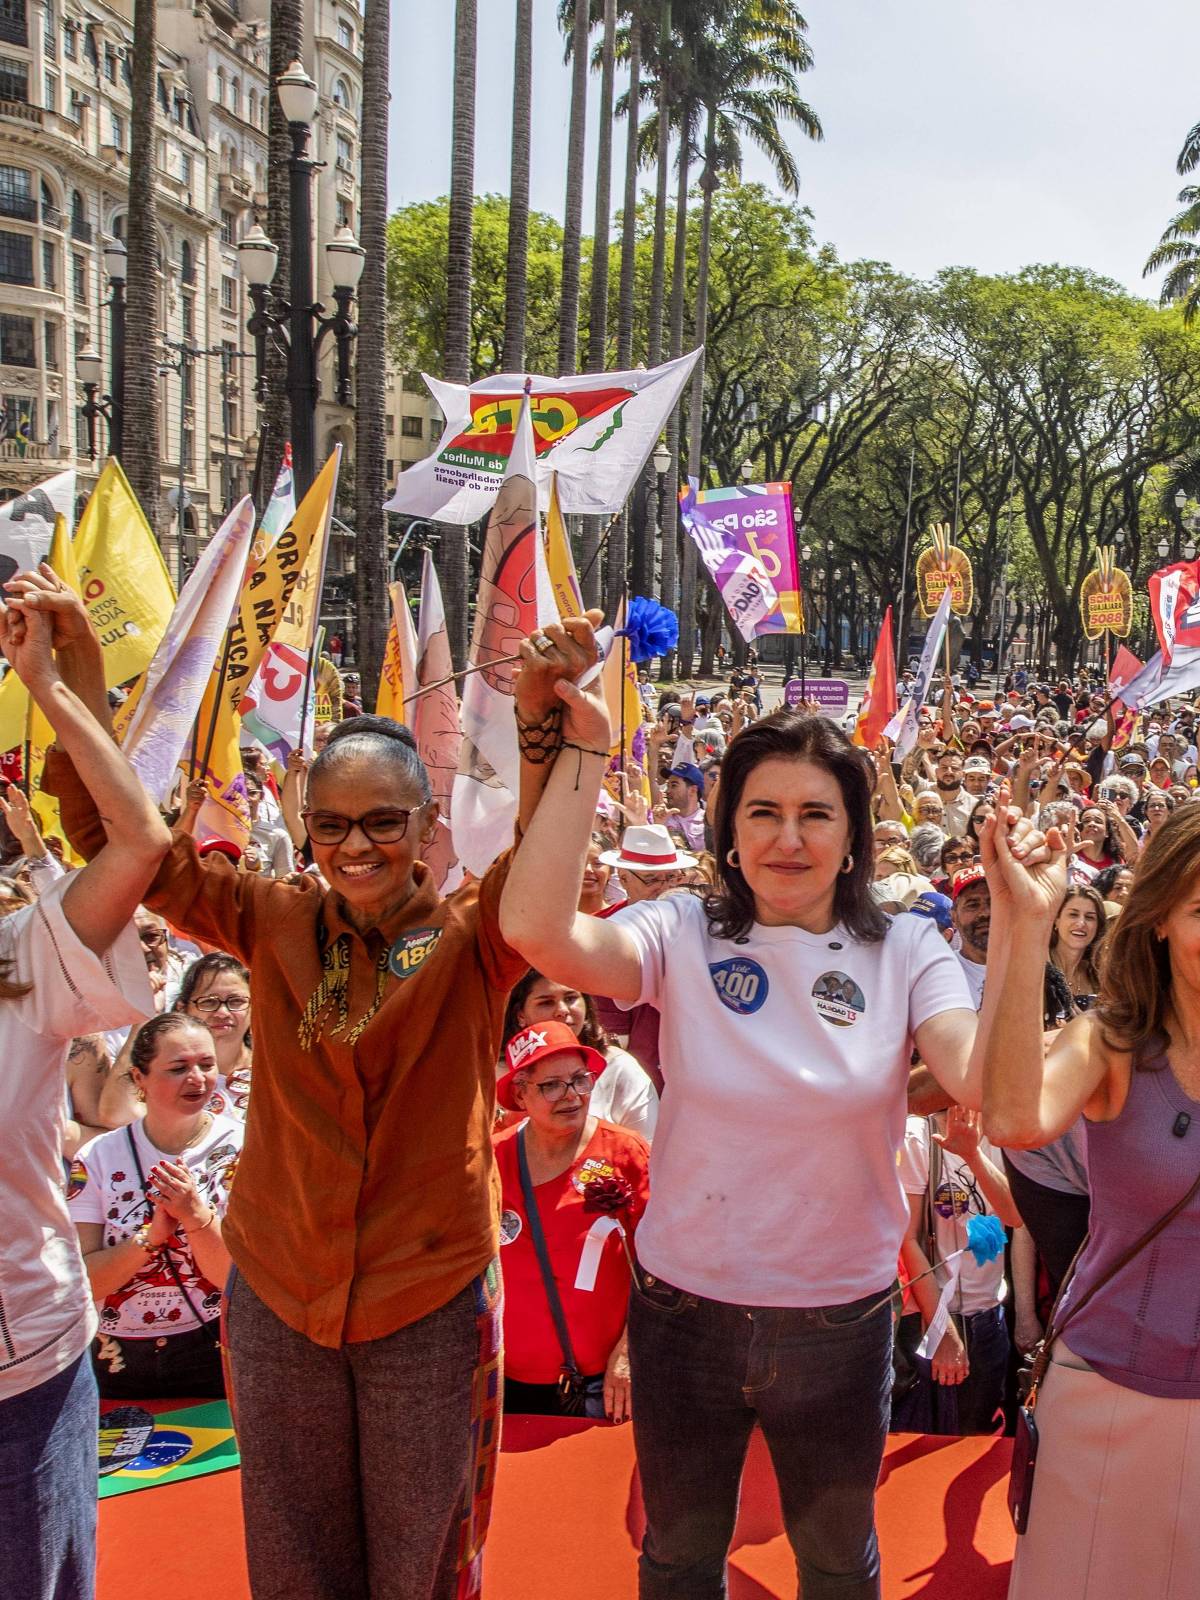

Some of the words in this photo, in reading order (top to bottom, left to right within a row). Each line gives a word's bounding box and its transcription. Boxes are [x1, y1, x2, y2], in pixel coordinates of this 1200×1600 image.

[929, 591, 962, 602] 508
[1090, 612, 1122, 625] 5088
[712, 969, 760, 1002] 400
[846, 1009, 857, 1022] 13
